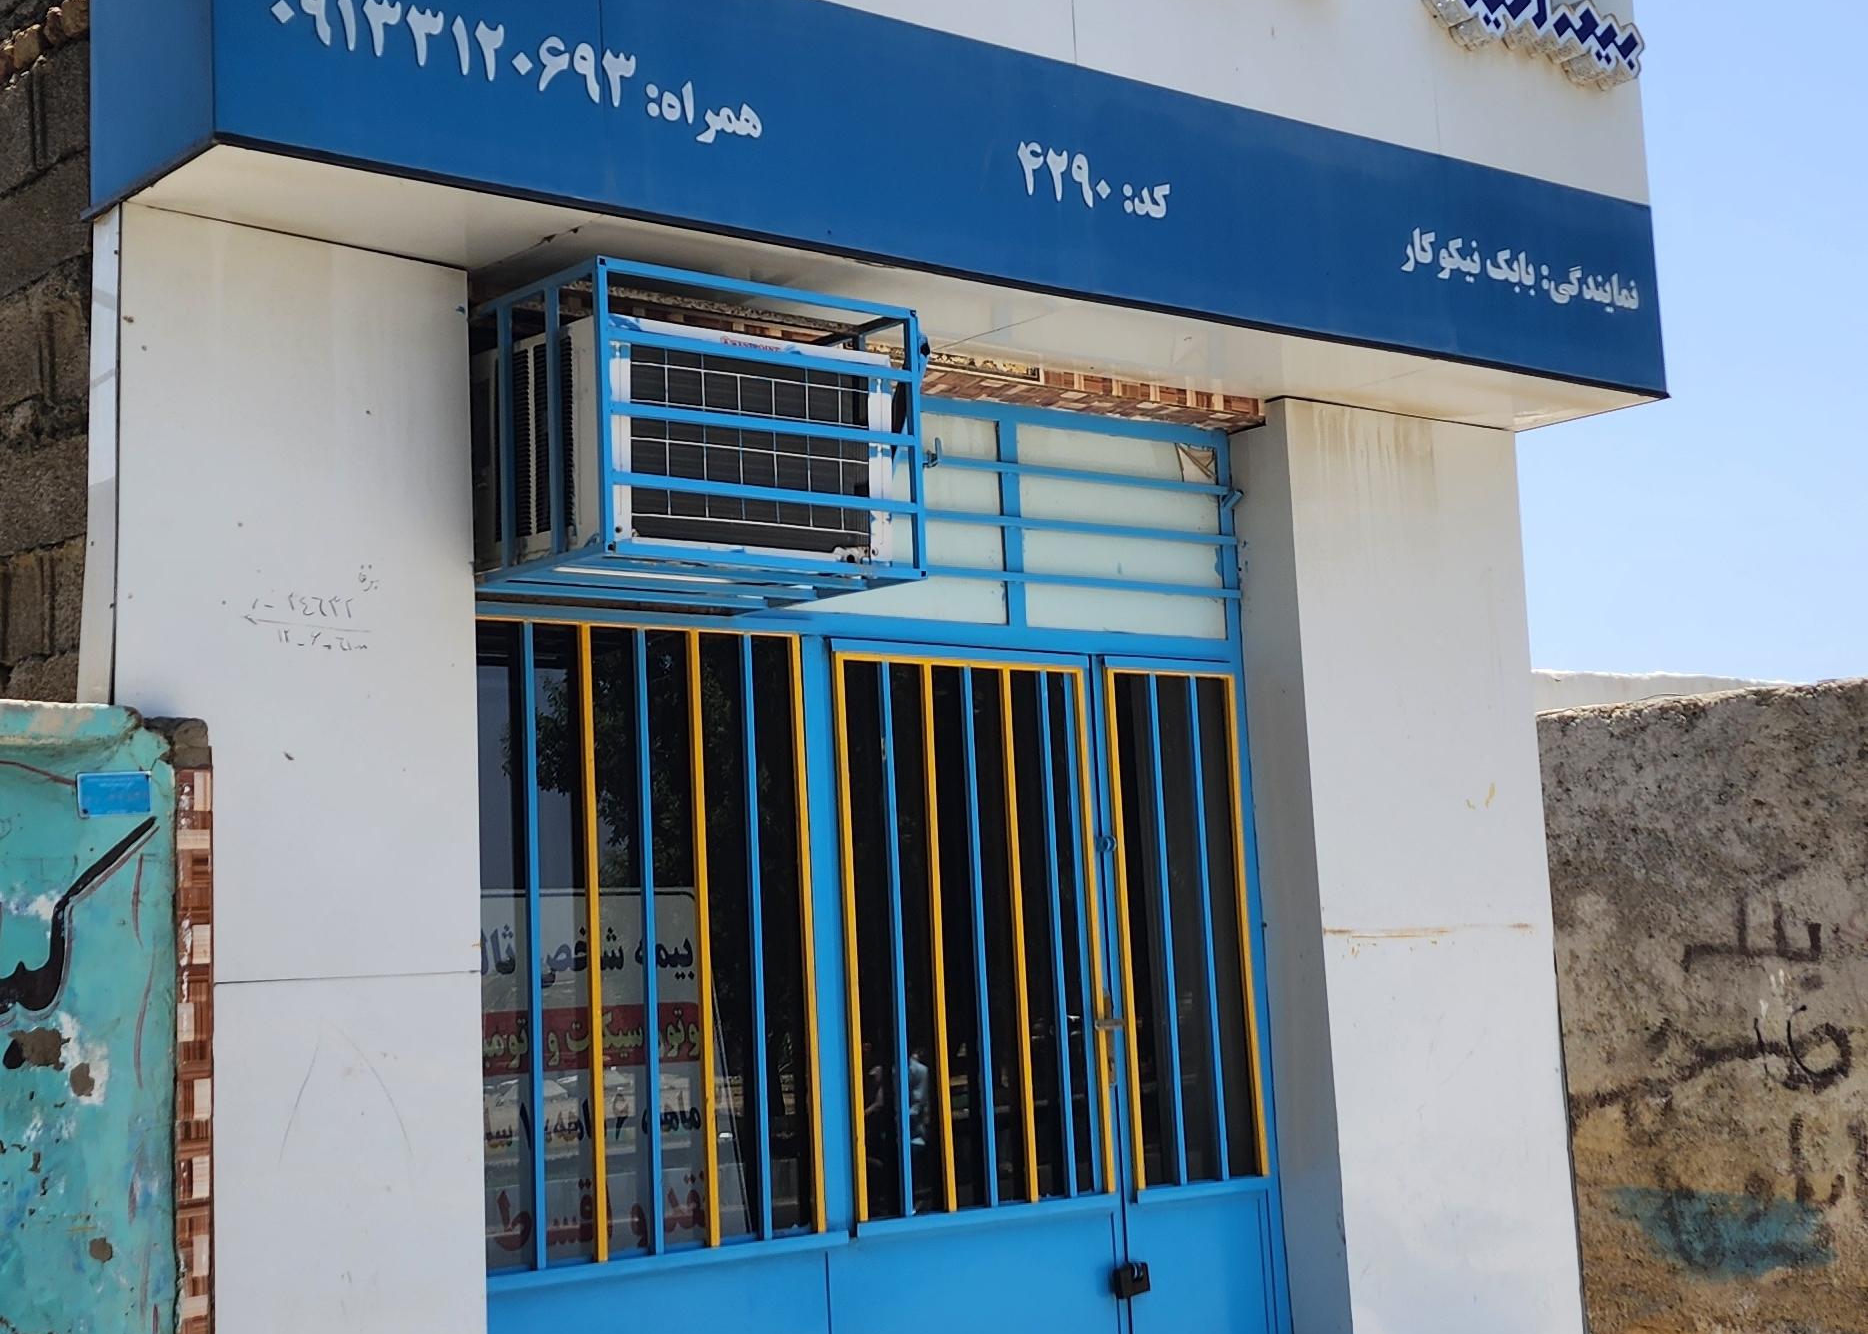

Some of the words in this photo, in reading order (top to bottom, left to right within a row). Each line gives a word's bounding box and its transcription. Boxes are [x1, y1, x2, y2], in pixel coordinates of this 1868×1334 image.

[645, 80, 764, 145] همراه:
[1017, 141, 1112, 209] ۴۲۹۰
[1122, 182, 1171, 220] کد:
[1486, 249, 1536, 297] بابک
[1541, 265, 1640, 314] نمایندگی:
